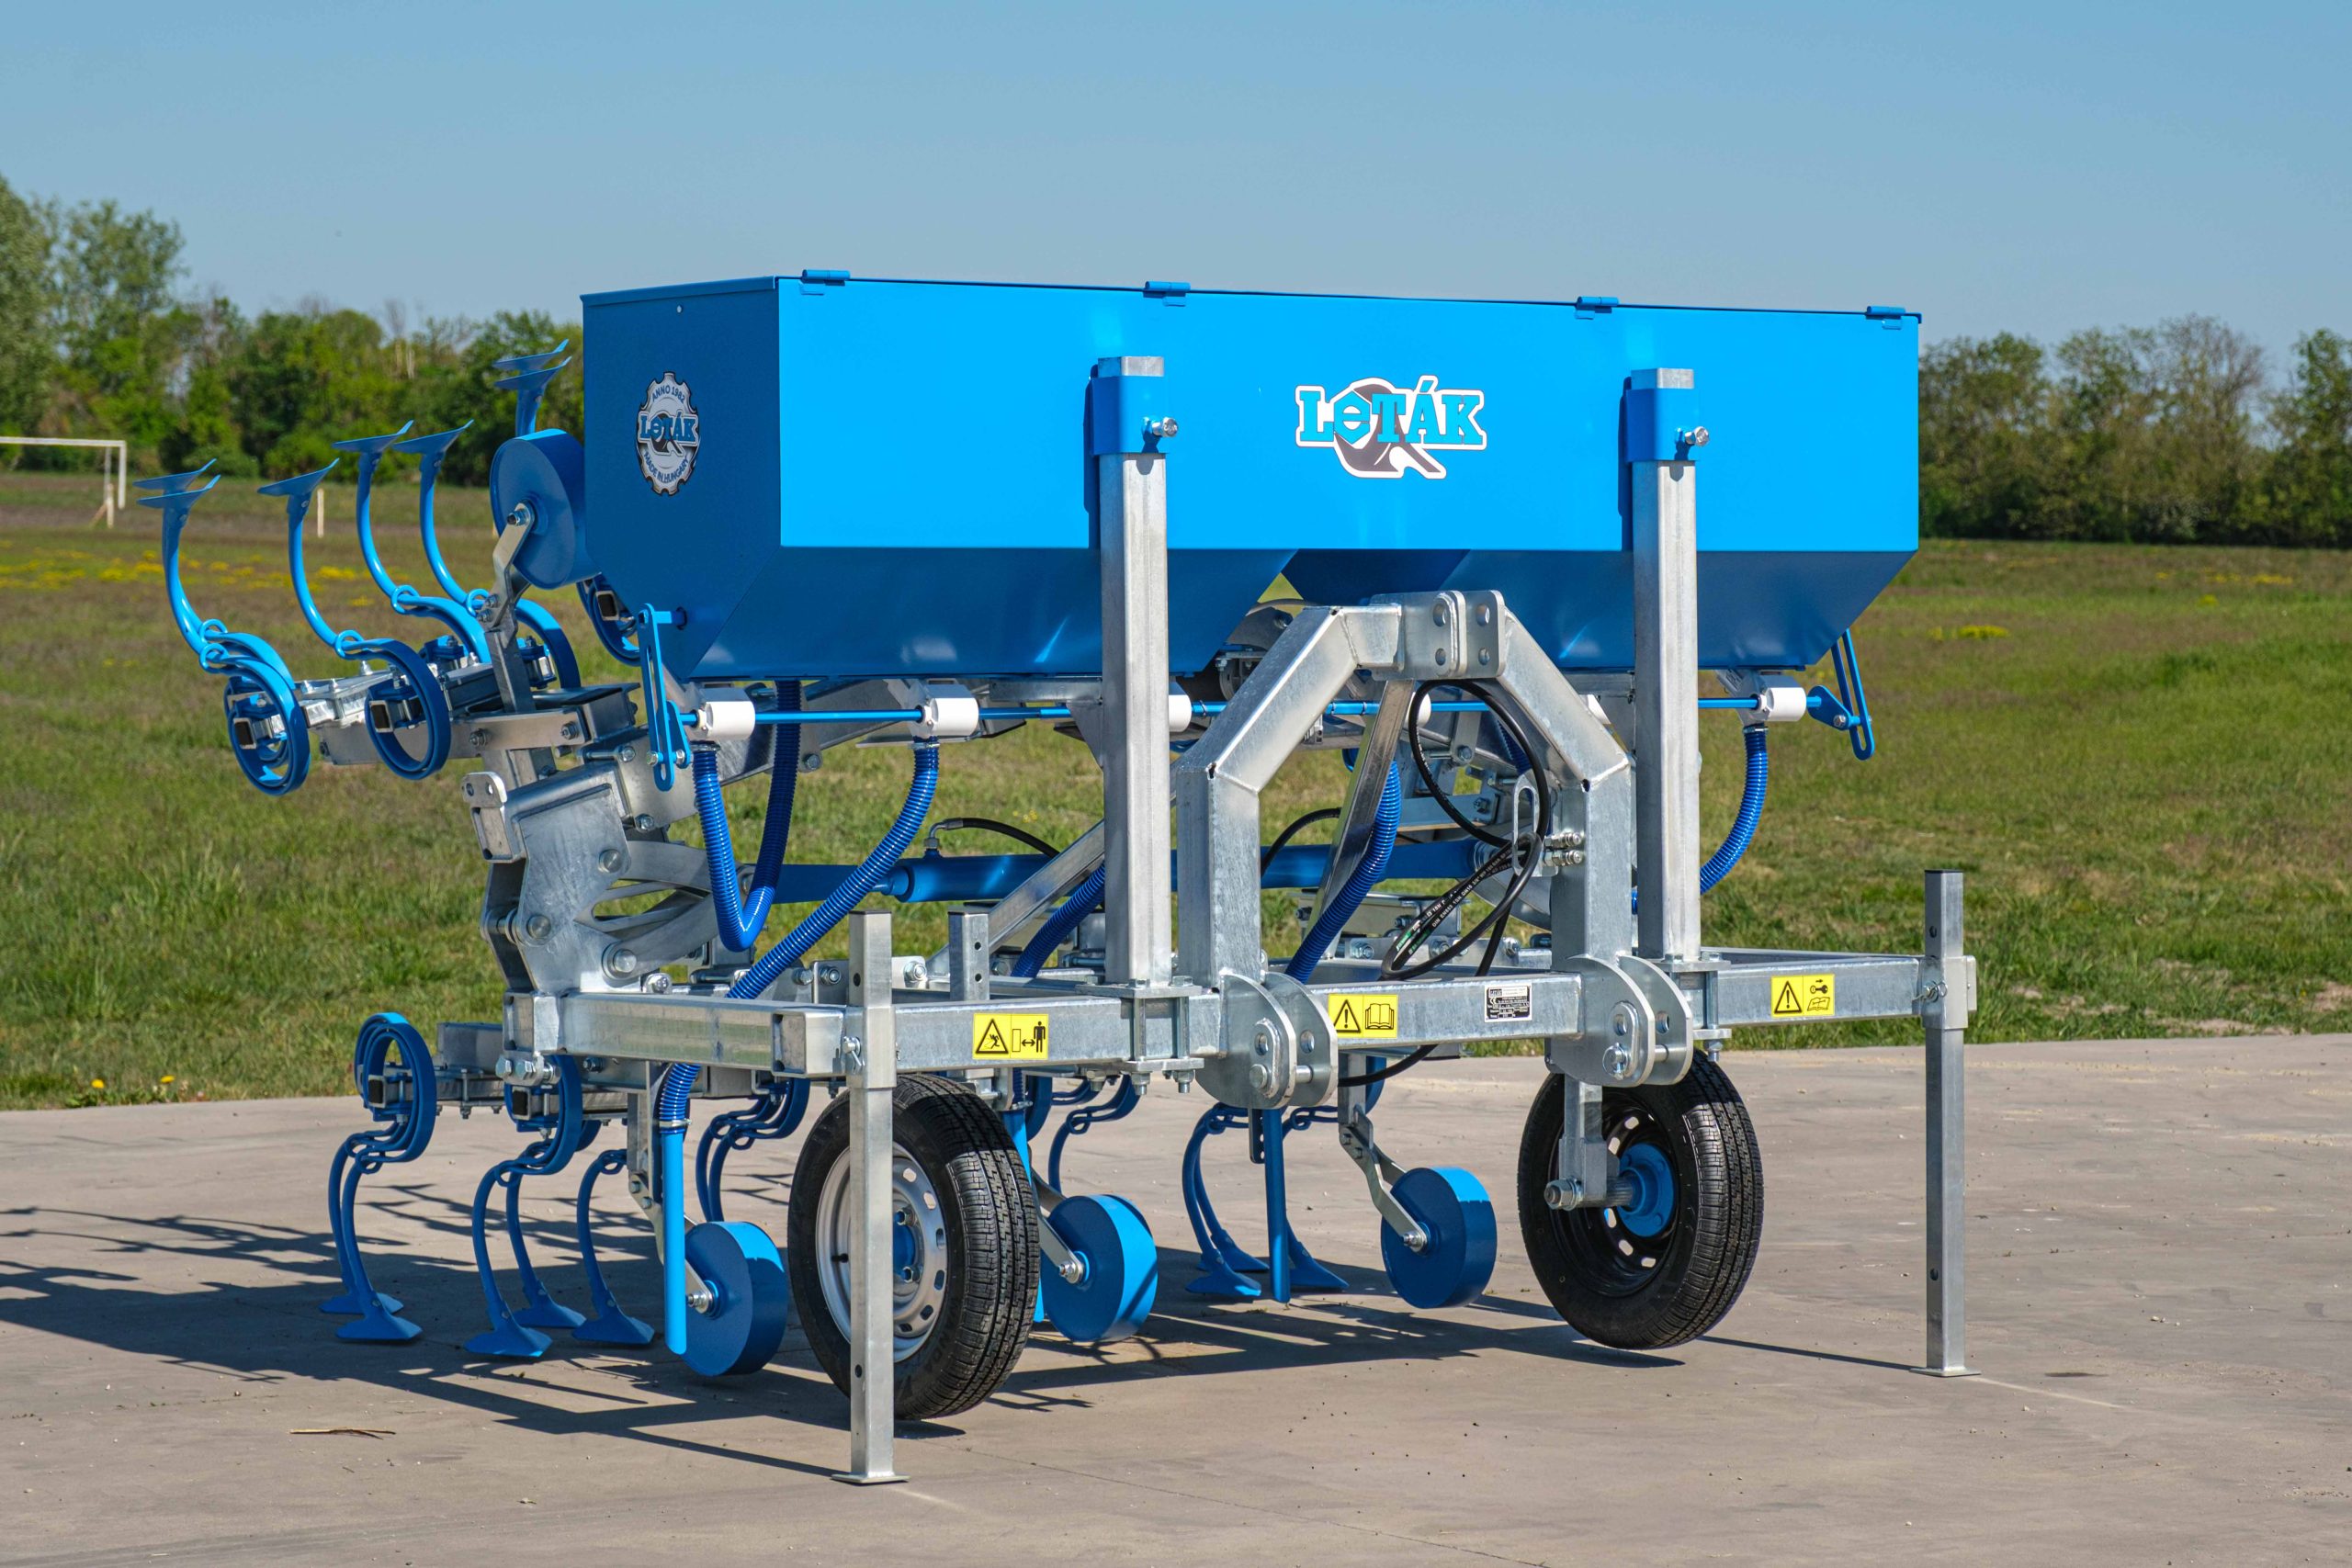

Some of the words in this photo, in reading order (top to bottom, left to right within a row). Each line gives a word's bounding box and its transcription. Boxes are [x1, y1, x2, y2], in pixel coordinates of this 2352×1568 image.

[651, 385, 672, 402] ANNO
[672, 386, 685, 403] 1982
[644, 451, 658, 478] MADE
[664, 456, 688, 483] HUNGARY
[1431, 918, 1441, 928] DIN
